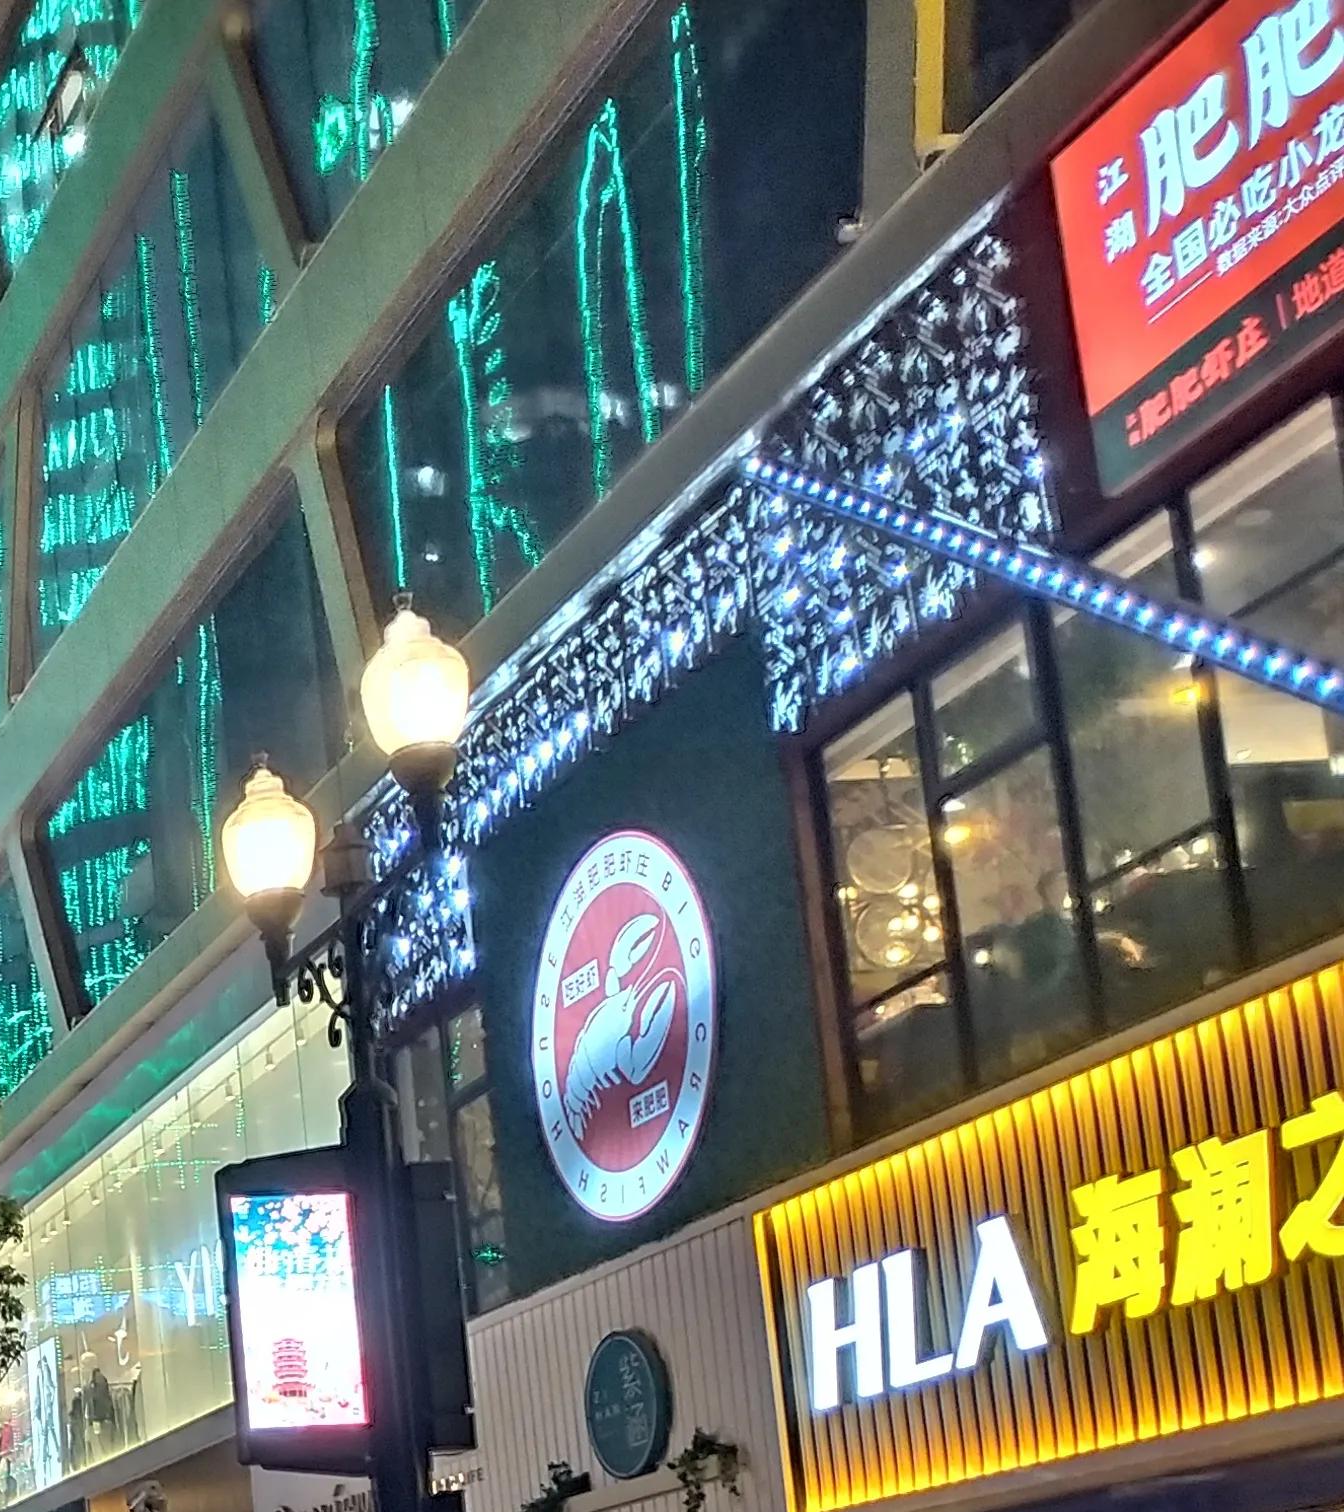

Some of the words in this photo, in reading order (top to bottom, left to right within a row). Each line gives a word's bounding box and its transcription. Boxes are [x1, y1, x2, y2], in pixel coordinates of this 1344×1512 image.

[1139, 0, 1344, 237] 肥肥
[662, 871, 701, 959] BIG
[807, 1214, 1049, 1414] HLA
